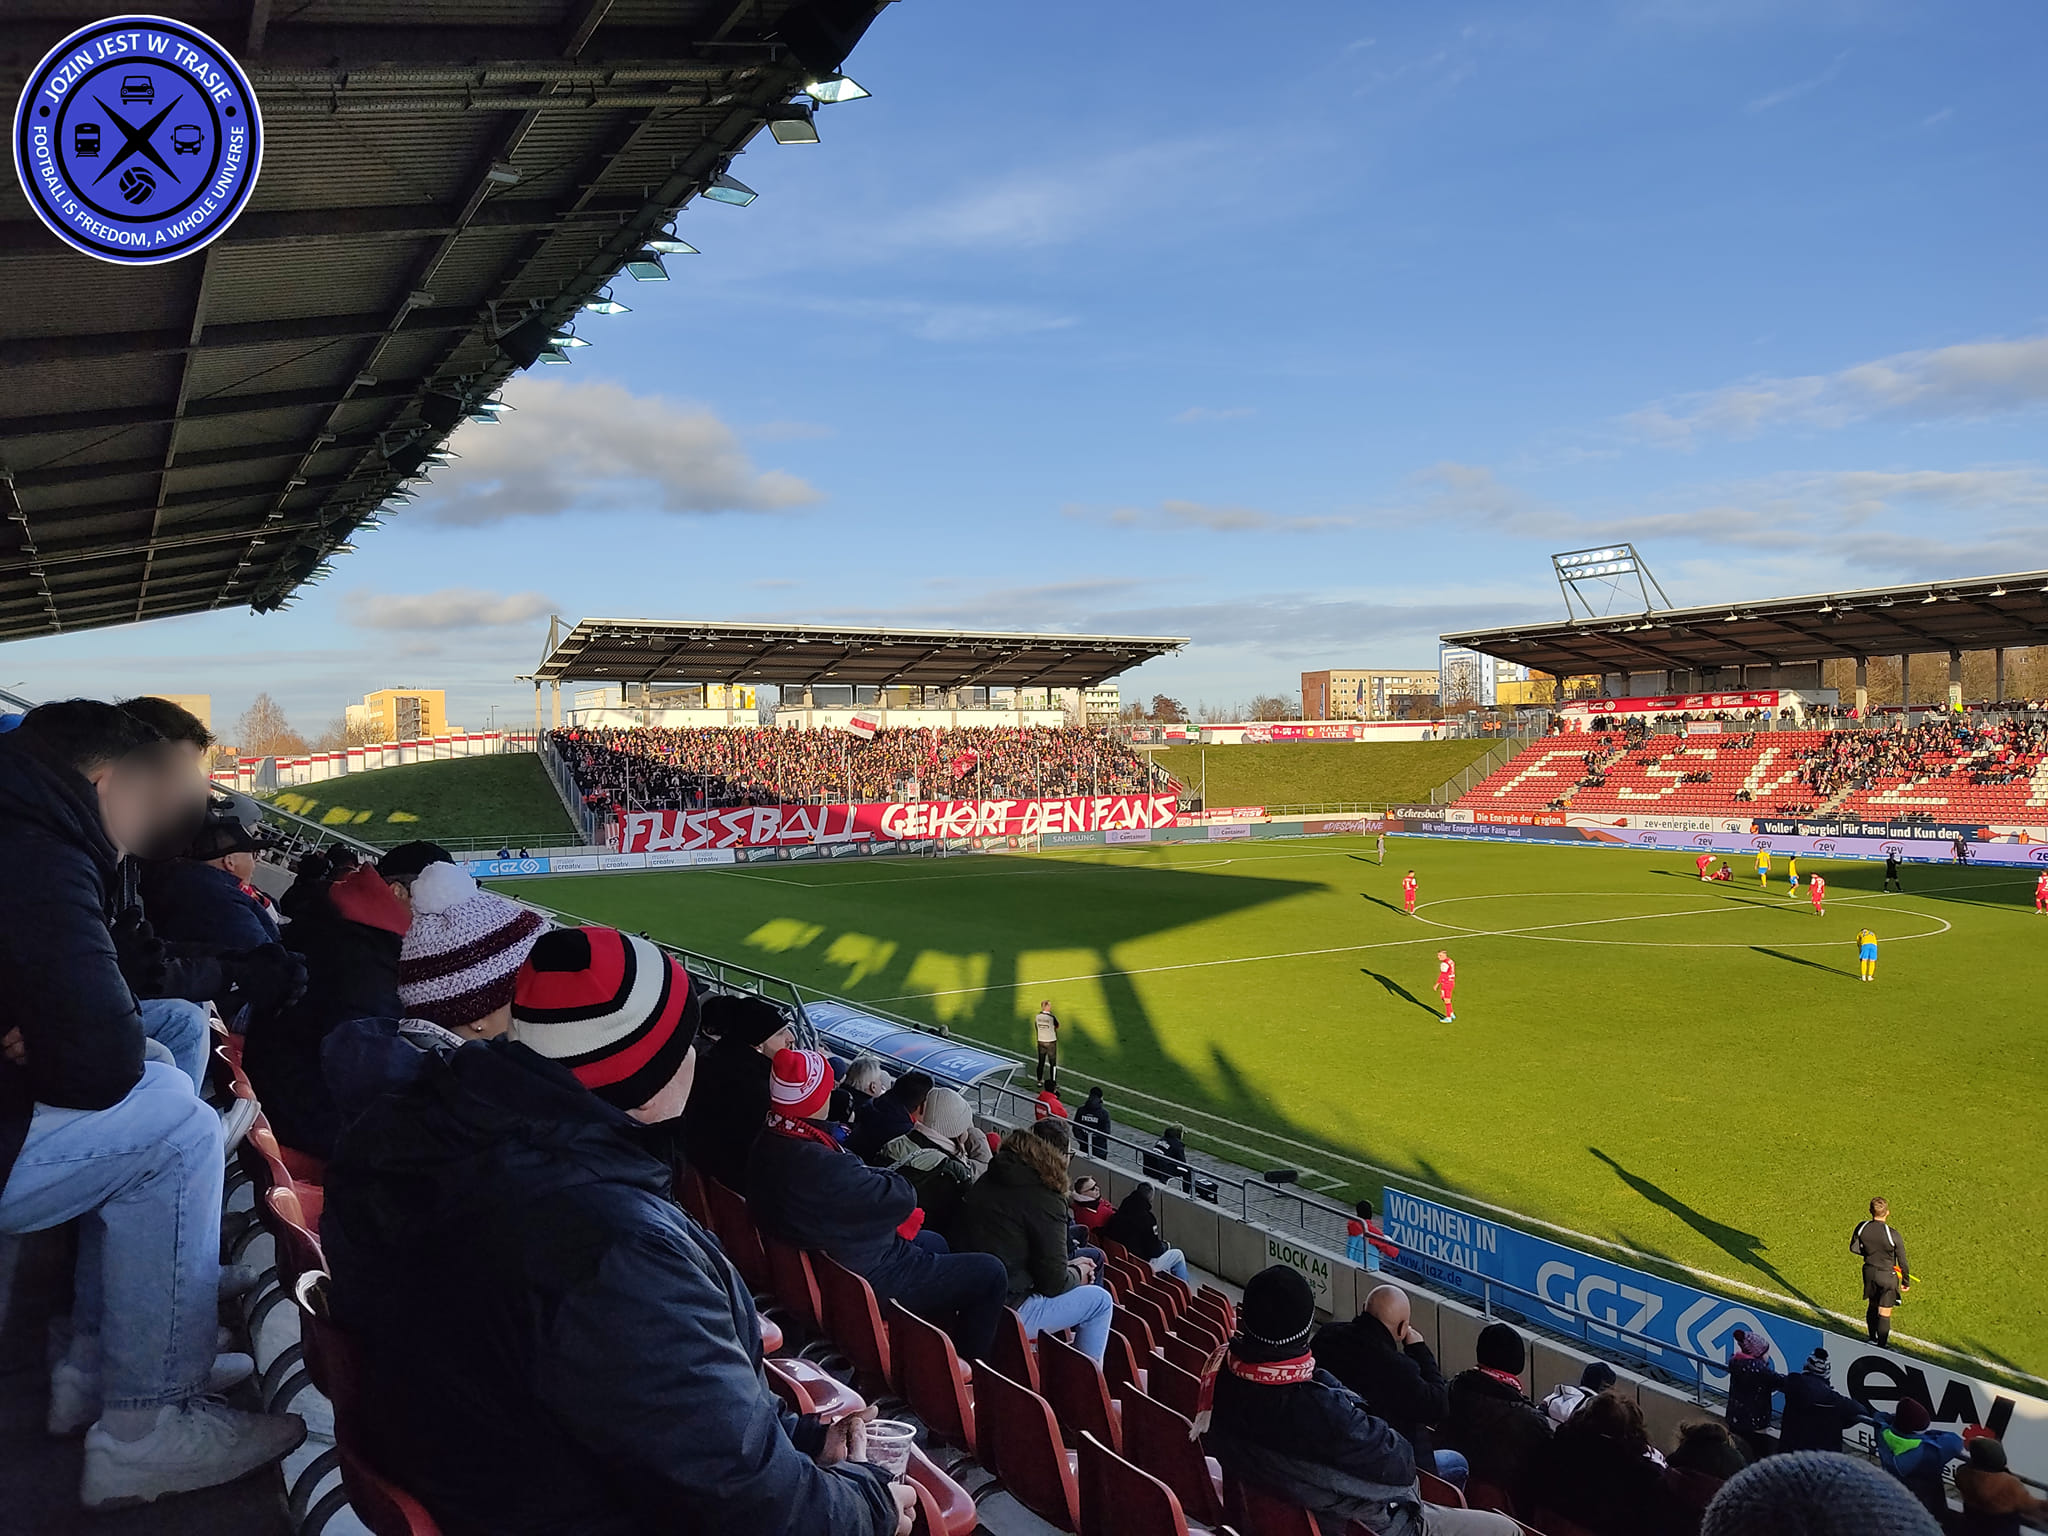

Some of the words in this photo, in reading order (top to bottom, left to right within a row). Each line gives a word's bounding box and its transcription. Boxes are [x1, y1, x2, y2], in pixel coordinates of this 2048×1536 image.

[1396, 808, 1445, 820] Eckersbach
[1476, 812, 1489, 822] Die
[1489, 813, 1518, 824] Energie
[1519, 814, 1533, 824] der
[1541, 815, 1564, 827] egion.
[622, 806, 872, 853] FUSSBALL
[881, 800, 1017, 840] GEHÖRT
[1021, 797, 1088, 835] DEN
[1090, 795, 1176, 832] FANS
[1422, 822, 1433, 831] Mit
[1433, 823, 1451, 832] voller
[1452, 824, 1479, 835] Energie!
[1479, 825, 1490, 834] Für
[1491, 826, 1506, 835] Fans
[1508, 828, 1521, 837] und
[1644, 816, 1710, 831] zev-energie.de
[1726, 821, 1741, 831] zev
[1764, 822, 1794, 834] Voller
[1842, 823, 1859, 835] Für
[1861, 824, 1886, 836] Fans
[1890, 826, 1911, 838] und
[1052, 833, 1097, 843] SAMMLUNG.
[1643, 834, 1657, 844] zev
[1698, 837, 1713, 847] zev
[1756, 839, 1772, 849] zev
[1818, 841, 1836, 852] zev
[1885, 845, 1904, 857] zev
[489, 862, 519, 875] GGZ
[940, 1055, 985, 1072] zev
[1389, 1194, 1470, 1245] WOHNEN
[1476, 1223, 1497, 1254] IN
[1390, 1221, 1479, 1273] ZWICKAU
[1269, 1240, 1309, 1272] BLOCK
[1311, 1257, 1329, 1280] A4
[1536, 1260, 1663, 1357] GGZ
